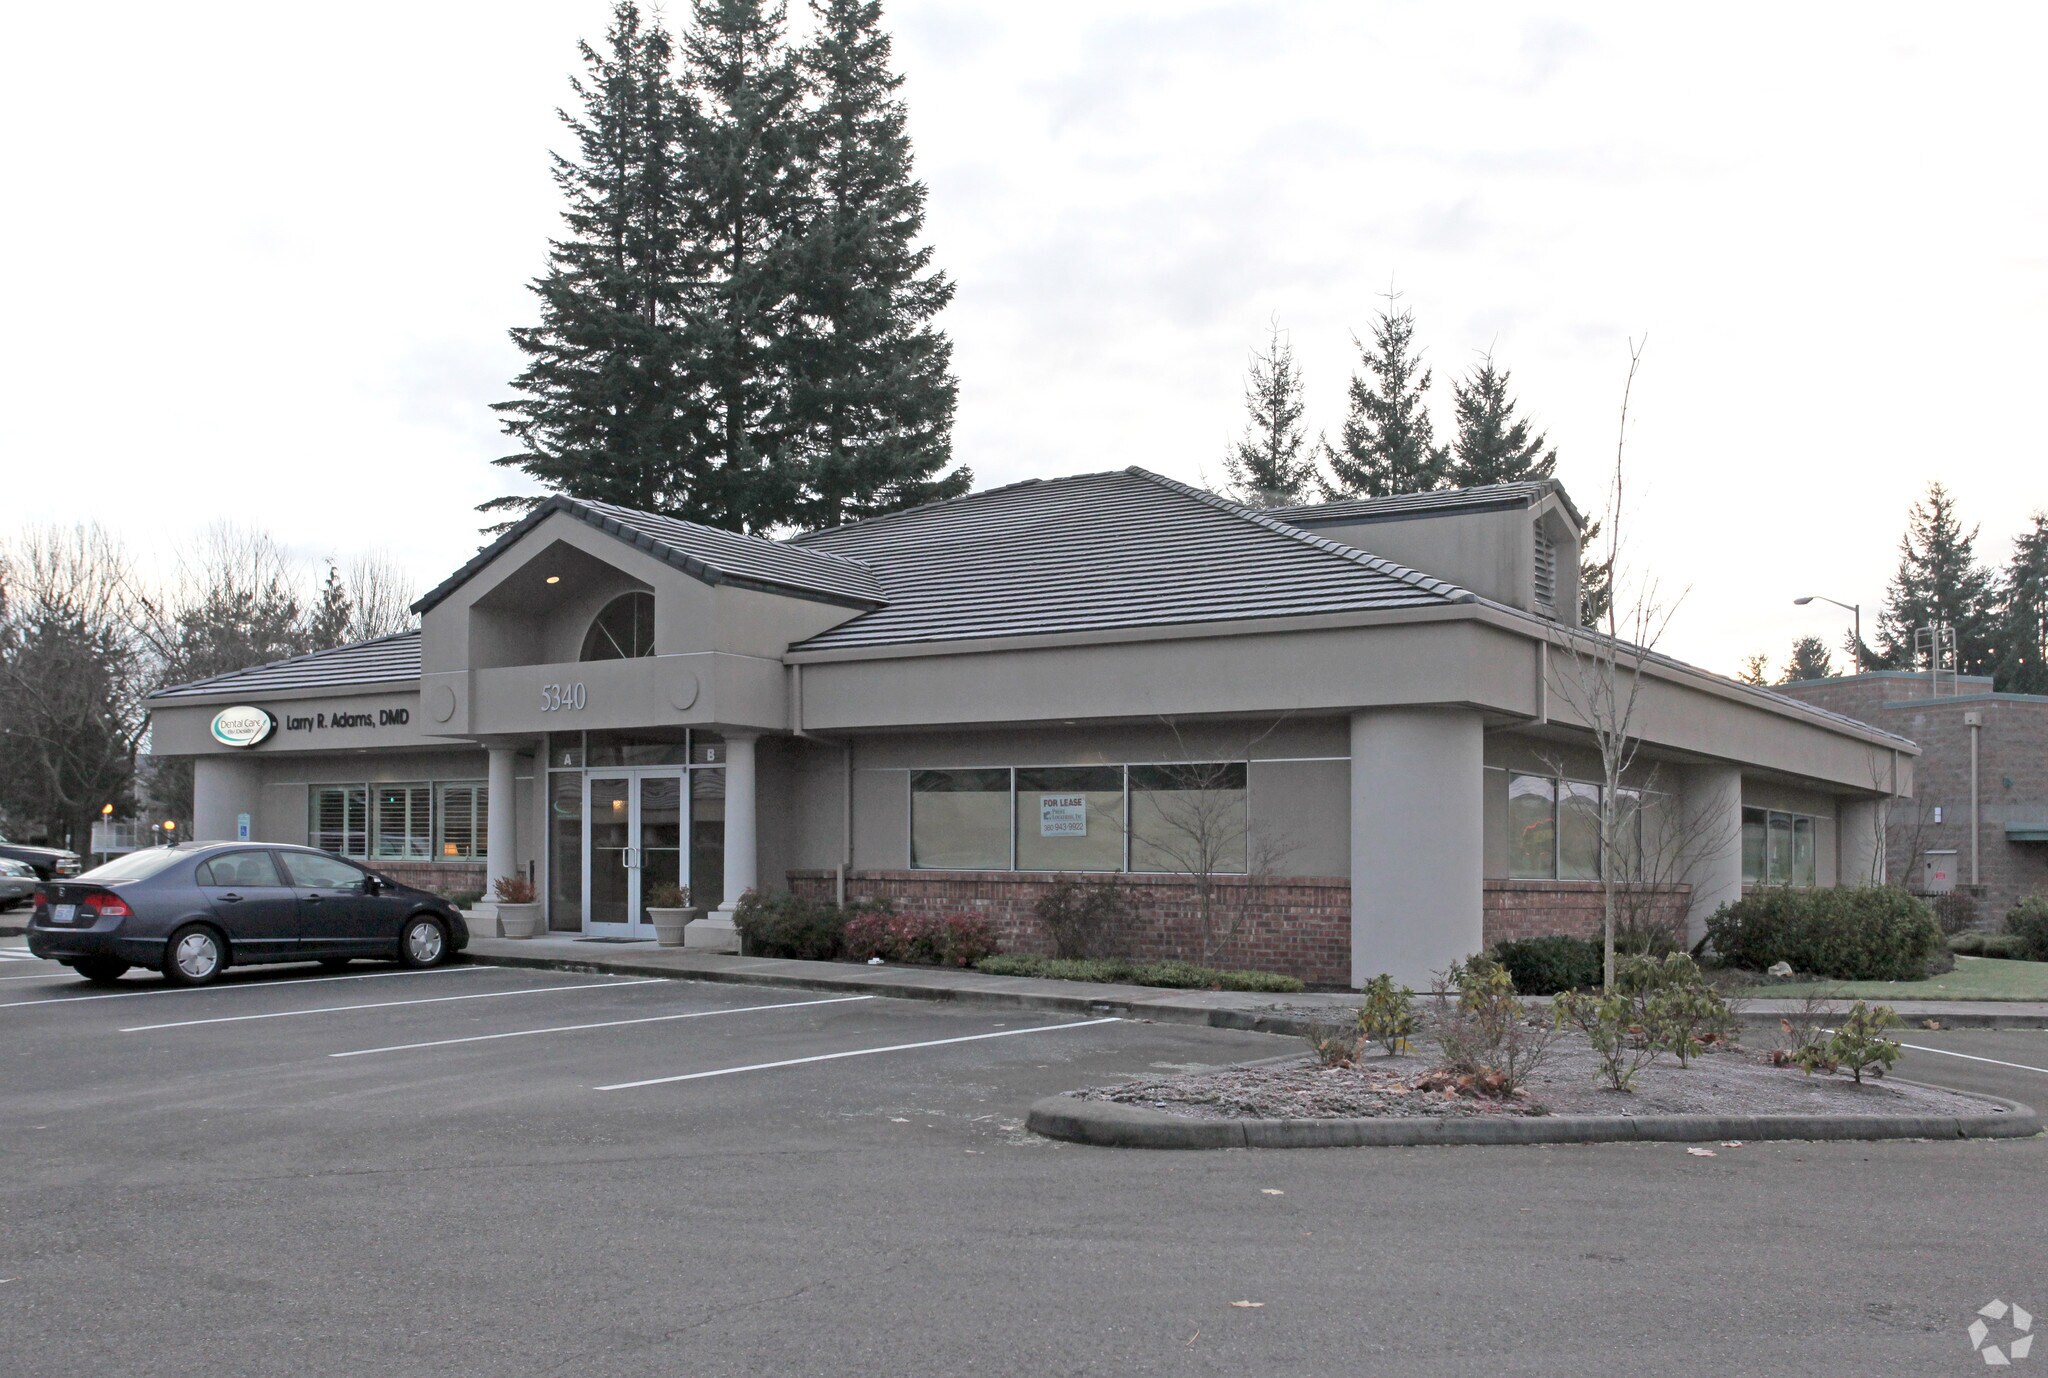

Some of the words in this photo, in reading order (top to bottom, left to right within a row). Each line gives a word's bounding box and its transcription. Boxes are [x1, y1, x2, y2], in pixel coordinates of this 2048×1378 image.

[540, 682, 587, 712] 5340
[220, 719, 243, 729] Dental
[244, 718, 261, 728] Care
[286, 715, 314, 733] Larry
[317, 713, 328, 728] R.
[331, 712, 376, 729] Adams,
[379, 708, 410, 726] DMD
[563, 753, 572, 766] A
[706, 748, 715, 762] B
[1043, 799, 1058, 808] FOR
[1059, 798, 1083, 807] LEASE
[1043, 824, 1054, 832] 360
